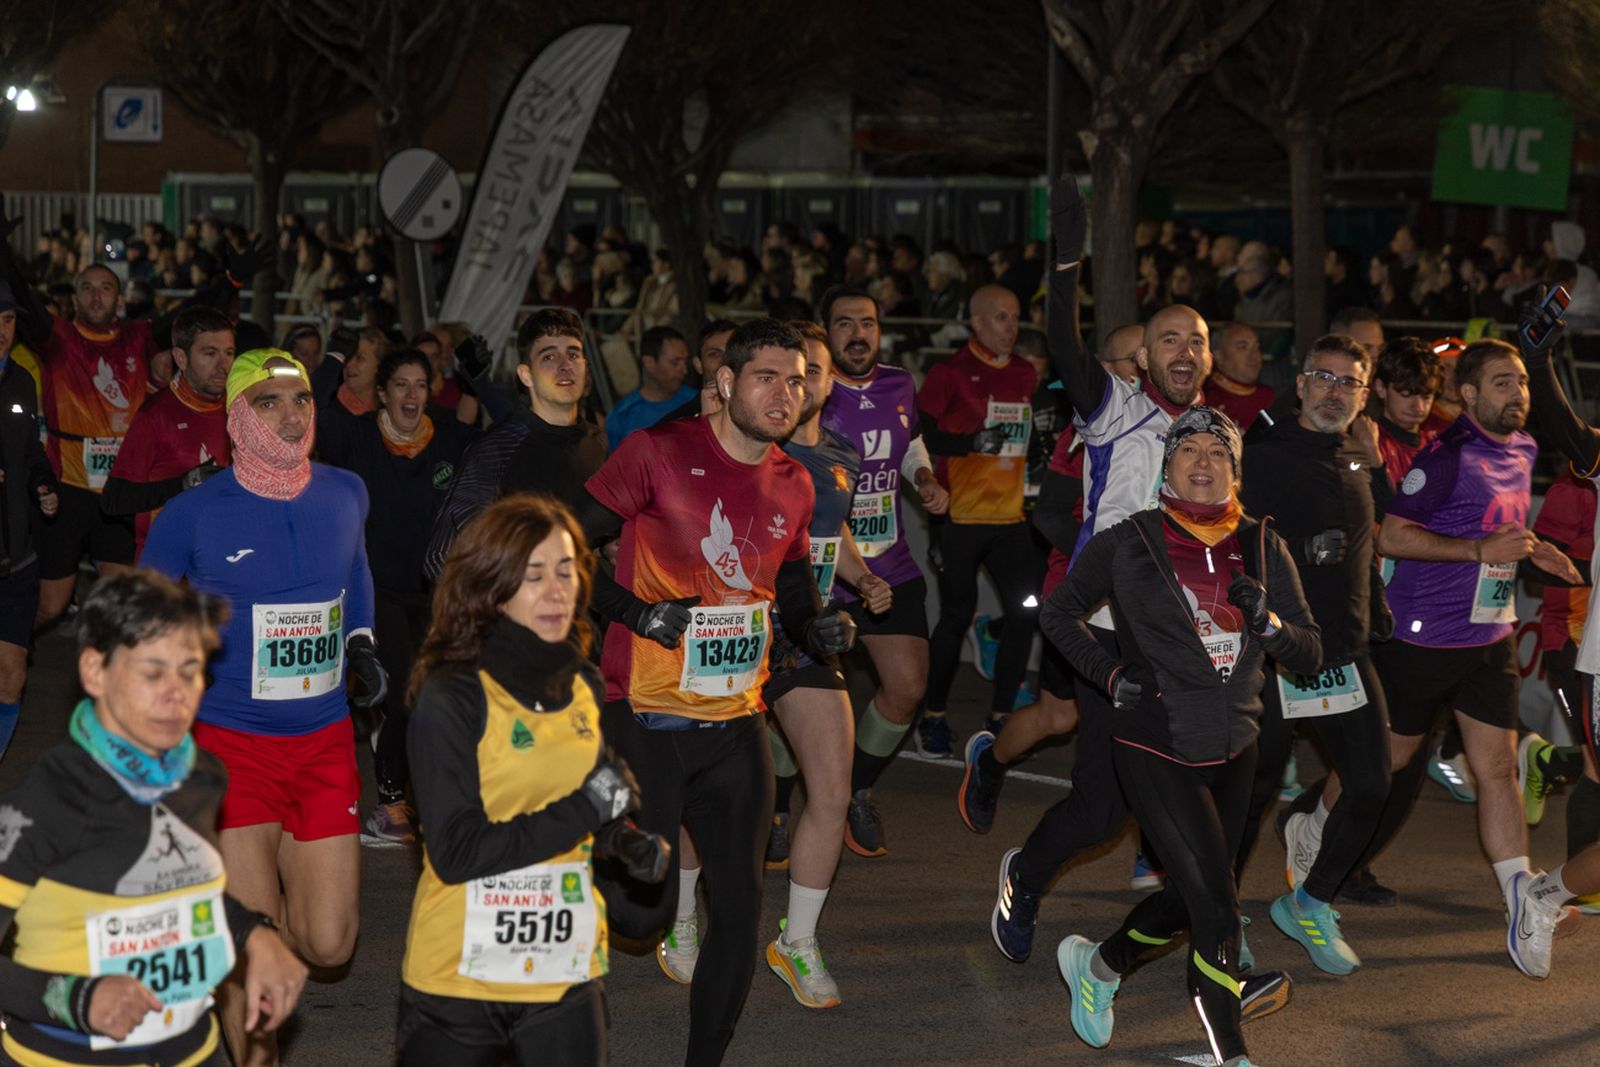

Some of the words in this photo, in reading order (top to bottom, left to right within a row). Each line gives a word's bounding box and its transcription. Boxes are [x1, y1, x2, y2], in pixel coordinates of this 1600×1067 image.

[1469, 122, 1543, 174] WC
[857, 462, 897, 493] aén
[715, 551, 738, 578] 43
[1493, 580, 1511, 600] 26
[278, 615, 310, 625] NOCHE
[311, 613, 322, 623] DE
[706, 616, 734, 626] NOCHE
[735, 615, 745, 624] DE
[265, 626, 286, 638] SAN
[288, 624, 322, 636] ANTÓN
[695, 627, 715, 638] SAN
[716, 625, 745, 637] ANTÓN
[266, 632, 338, 667] 13680
[696, 635, 760, 667] 13423
[1205, 644, 1222, 654] CHE
[1223, 643, 1234, 652] DE
[1211, 652, 1234, 665] NTÓN
[498, 880, 537, 891] NOCHE
[540, 879, 552, 889] DE
[484, 894, 509, 906] SAN
[513, 890, 553, 906] ANTÓN
[126, 917, 164, 933] NOCHE
[494, 909, 573, 944] 5519
[108, 940, 137, 957] SAN
[142, 929, 181, 953] ANTÓN
[127, 942, 207, 993] 2541
